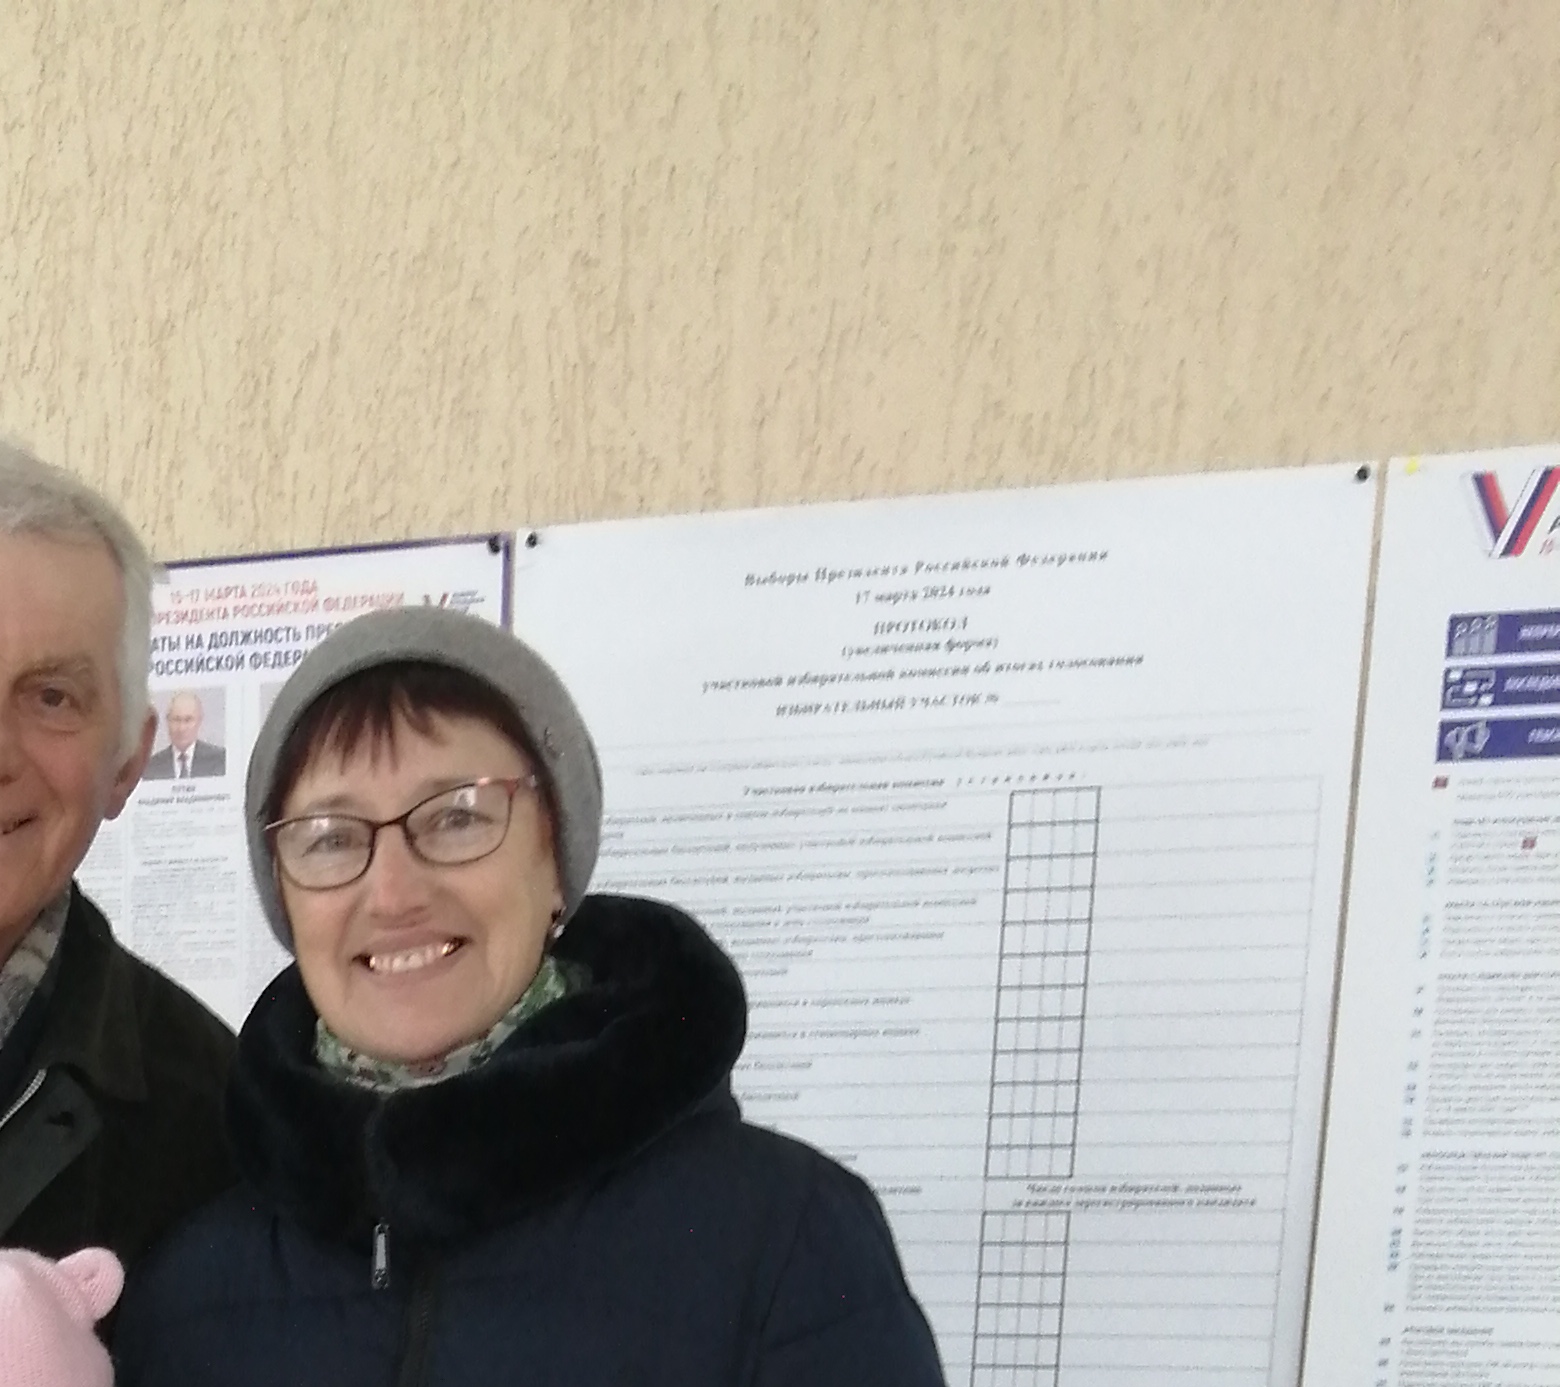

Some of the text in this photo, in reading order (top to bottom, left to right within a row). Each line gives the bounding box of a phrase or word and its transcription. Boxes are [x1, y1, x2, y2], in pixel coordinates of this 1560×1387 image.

[185, 633, 204, 650] НА
[207, 625, 301, 651] ДОЛЖНОСТЬ
[149, 652, 246, 677] ОССИЙСКОЙ
